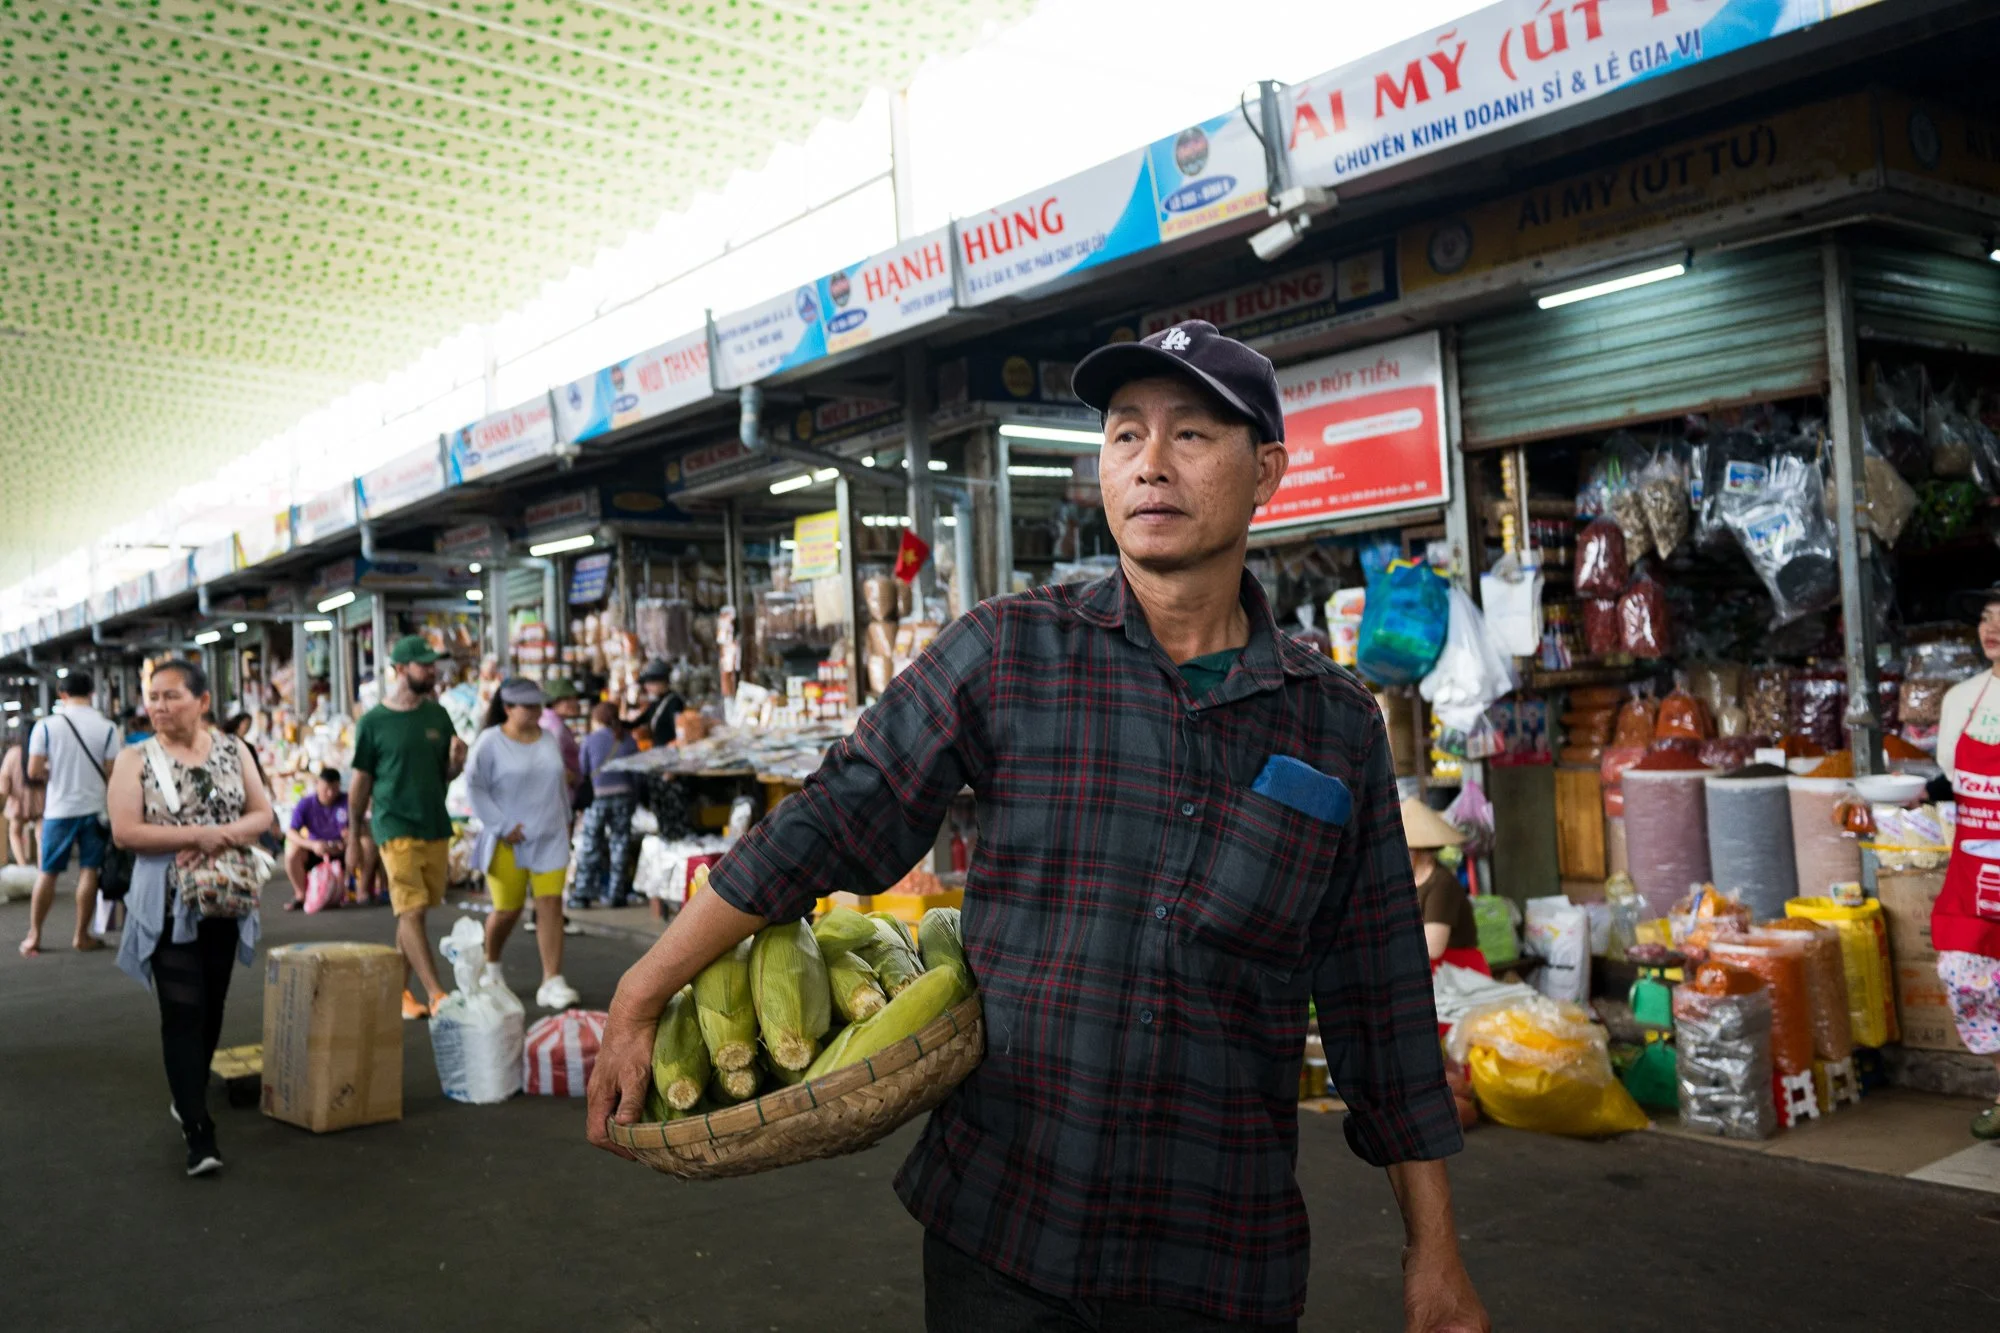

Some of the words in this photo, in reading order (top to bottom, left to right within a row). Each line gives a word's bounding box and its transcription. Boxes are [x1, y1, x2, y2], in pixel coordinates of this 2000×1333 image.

[1289, 85, 1348, 149] ÁI
[1374, 27, 1467, 119] MỸ
[1334, 131, 1405, 174] CHUYÊN
[1411, 117, 1457, 149] KINH
[1464, 88, 1534, 130] DOANH
[1571, 70, 1588, 96] &
[1629, 40, 1669, 74] GIA
[864, 241, 945, 303] HẠNH
[963, 196, 1064, 265] HÙNG
[1161, 327, 1191, 351] LA
